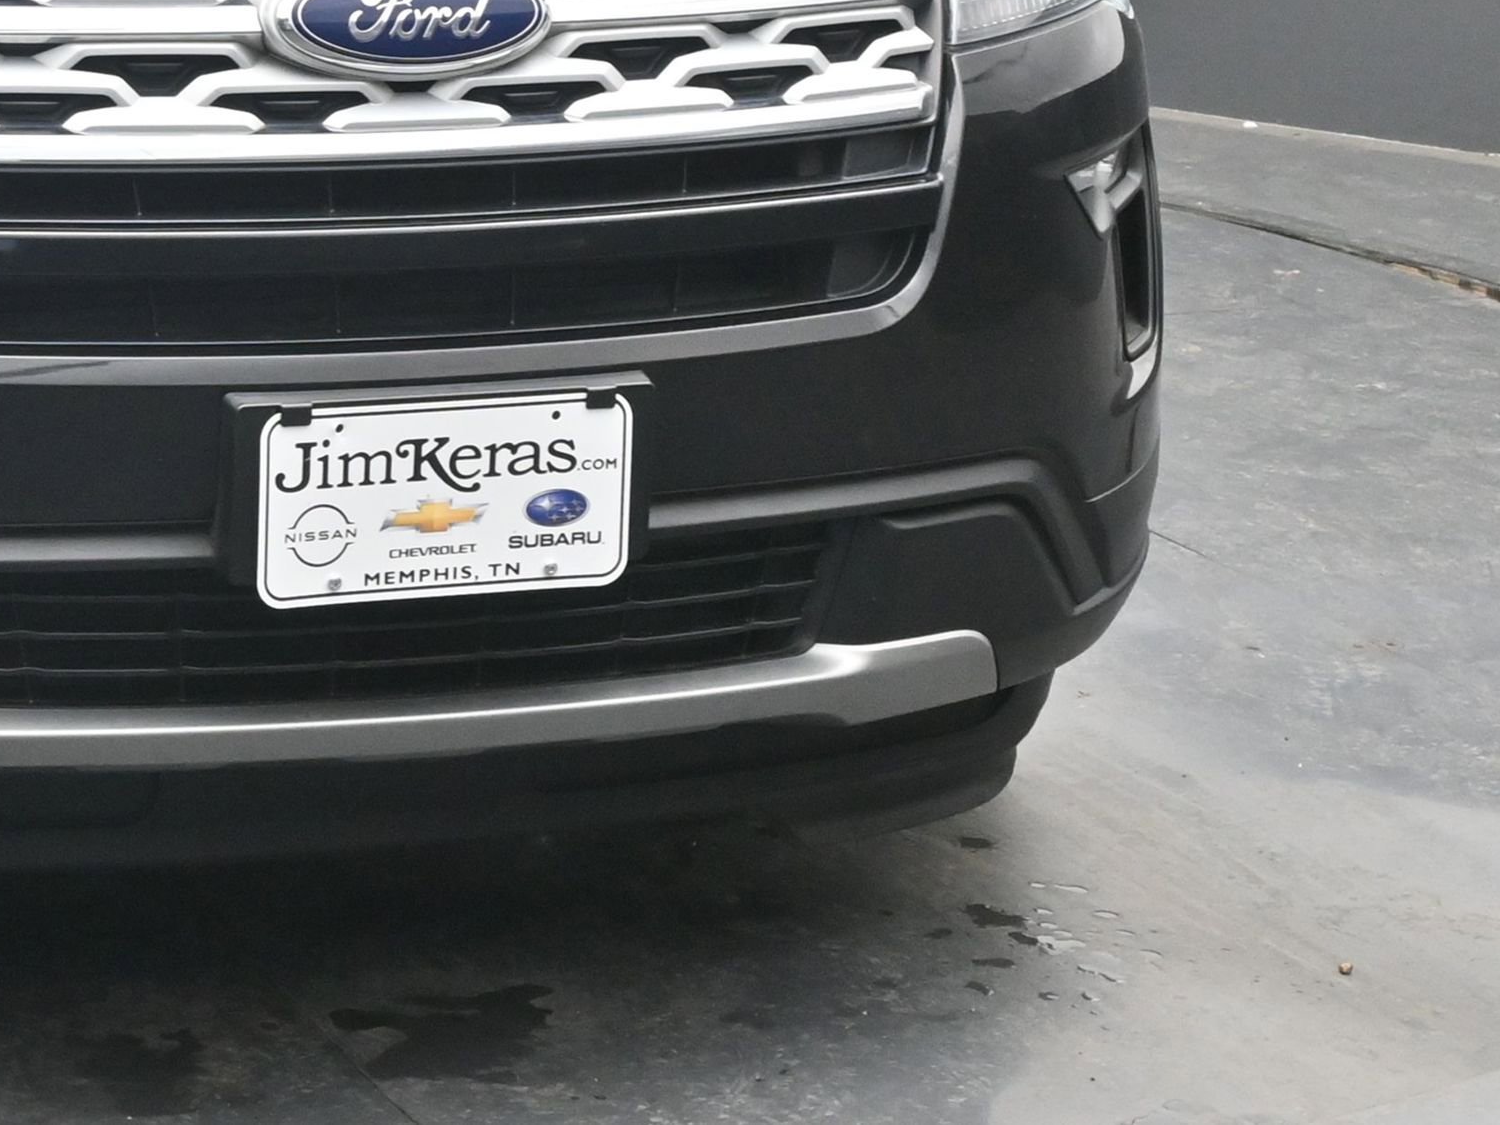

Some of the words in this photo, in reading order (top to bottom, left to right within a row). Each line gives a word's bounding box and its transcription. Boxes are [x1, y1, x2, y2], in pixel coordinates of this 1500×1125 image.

[285, 528, 357, 544] NISSAN
[508, 531, 603, 549] SUBARU
[389, 543, 477, 559] CHEVROLET
[364, 566, 480, 587] MEMPHIS,
[489, 562, 521, 576] TN
